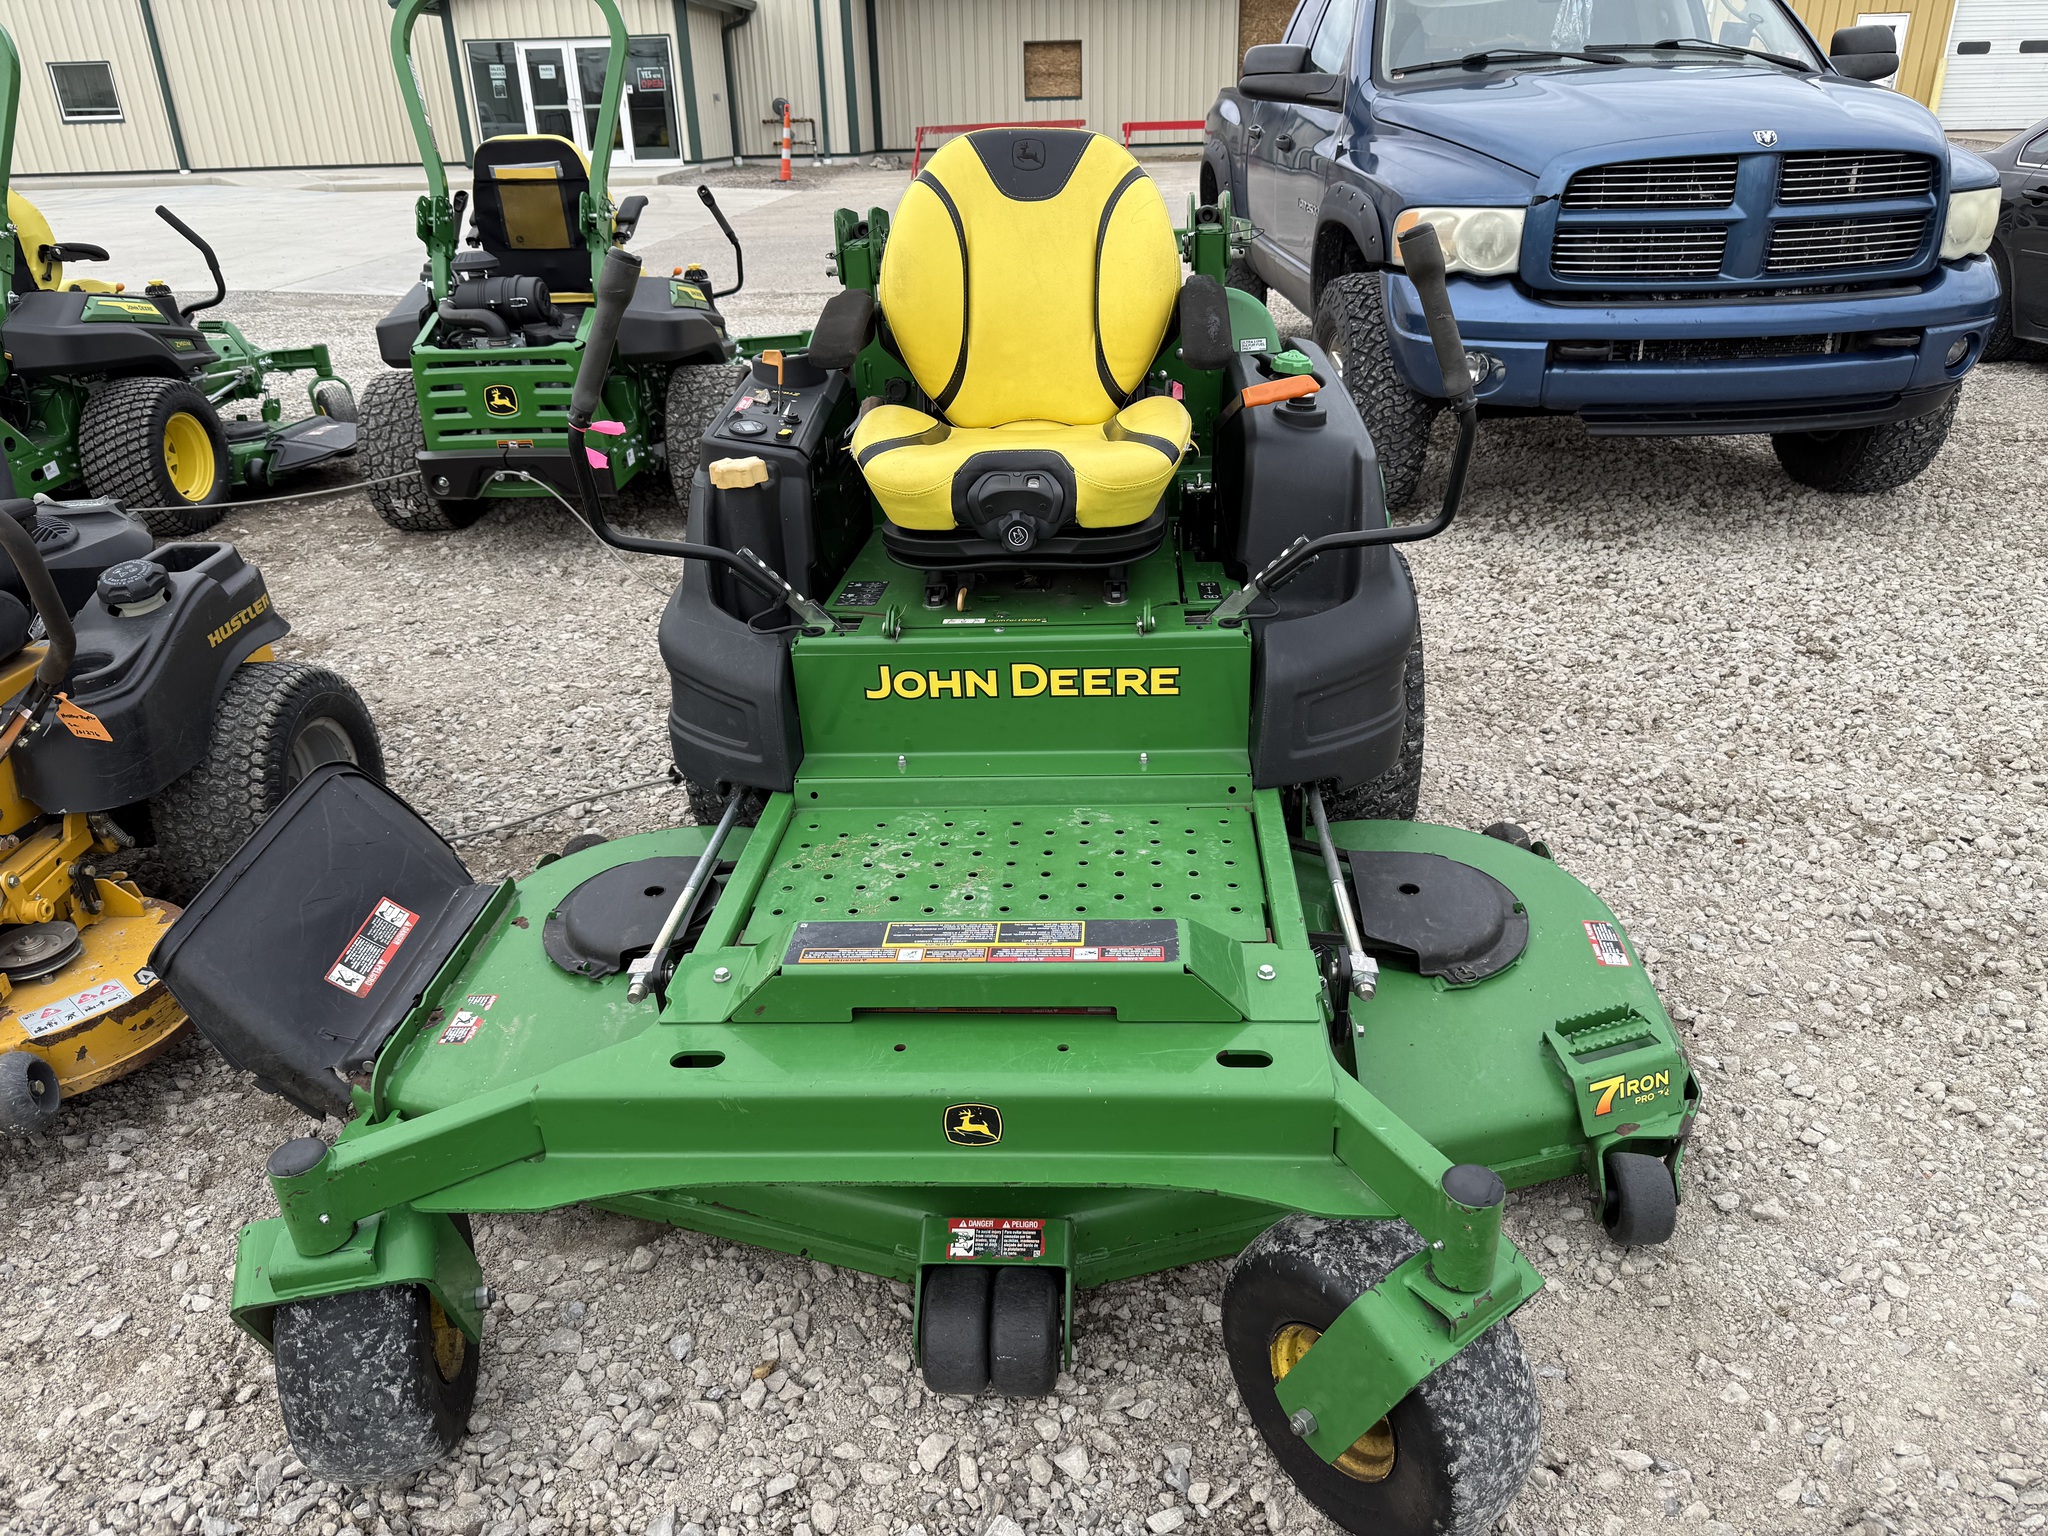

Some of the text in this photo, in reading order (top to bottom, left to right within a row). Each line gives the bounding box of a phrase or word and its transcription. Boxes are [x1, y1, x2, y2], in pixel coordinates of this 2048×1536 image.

[641, 79, 663, 88] OPEN
[207, 592, 270, 648] HUSTLER
[865, 662, 1181, 700] JOHN DEERE
[1635, 1092, 1654, 1105] PRO
